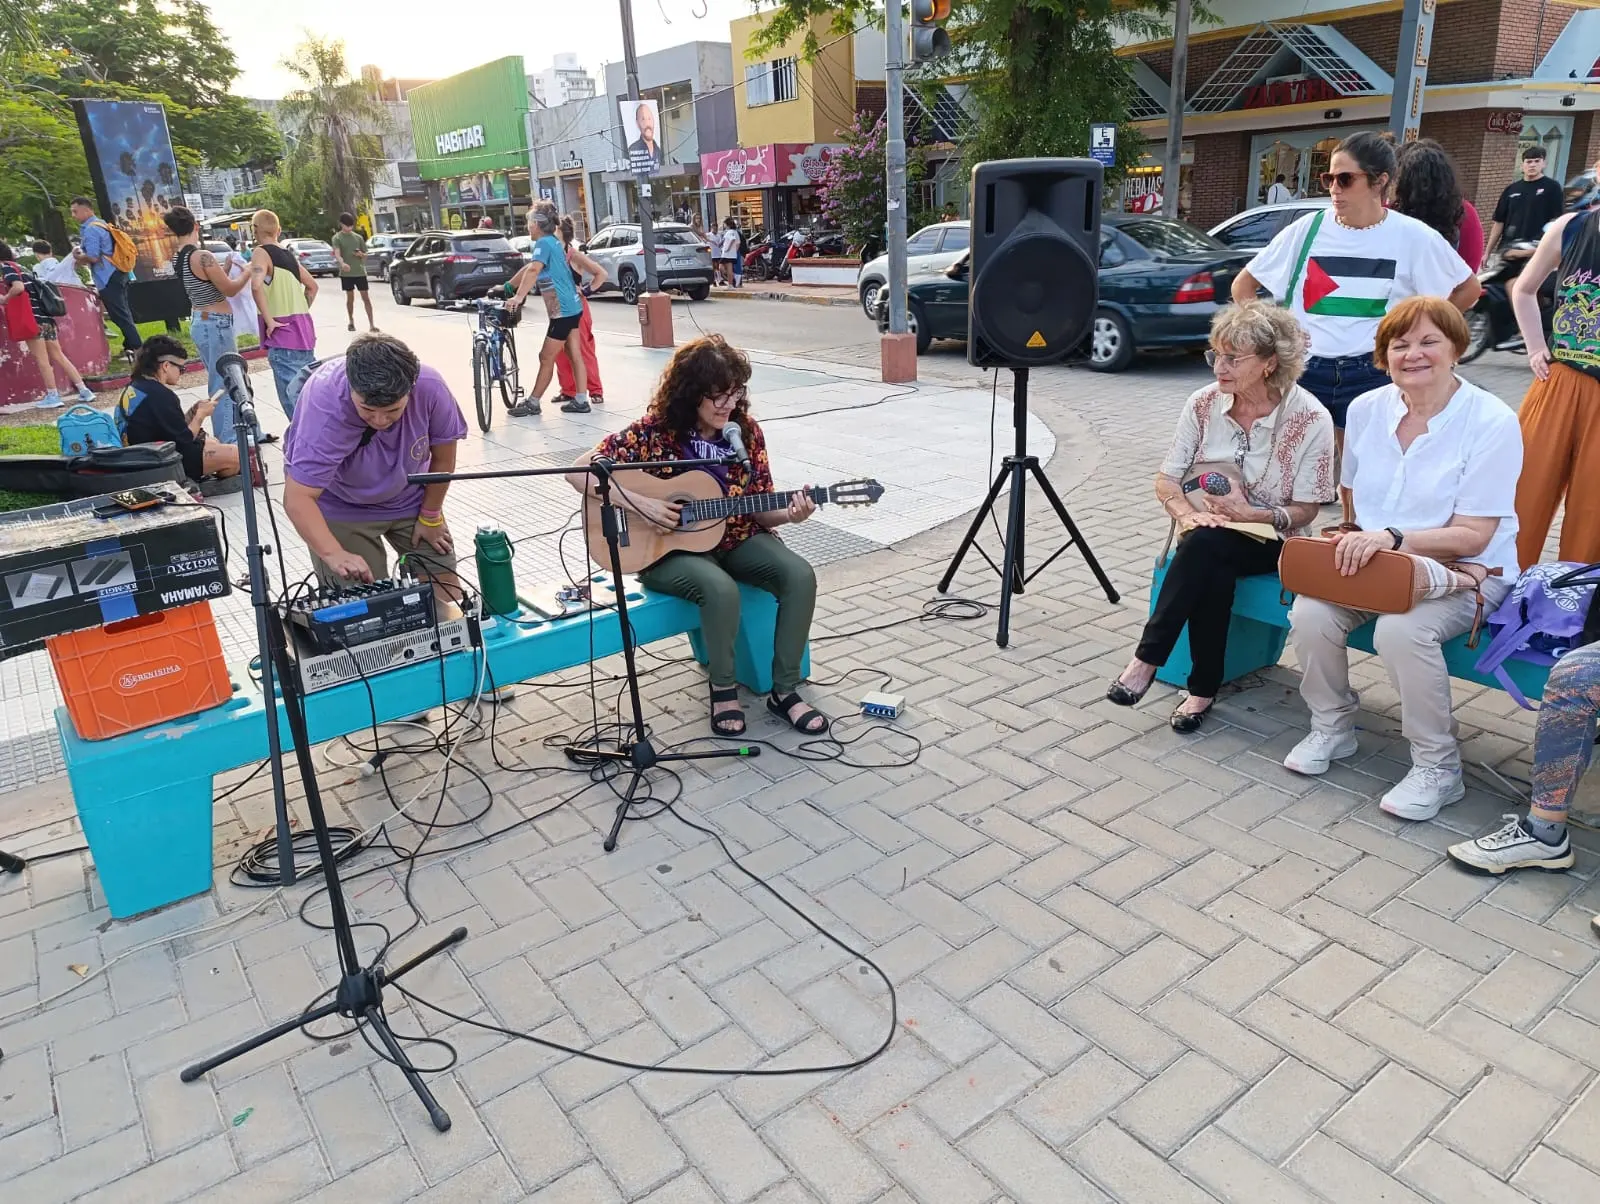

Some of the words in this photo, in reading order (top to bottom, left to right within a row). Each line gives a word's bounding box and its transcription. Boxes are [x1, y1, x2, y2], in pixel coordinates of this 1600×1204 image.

[1125, 176, 1162, 198] REBAJAS
[167, 556, 217, 574] MG12XU
[160, 585, 209, 604] YAMAHA
